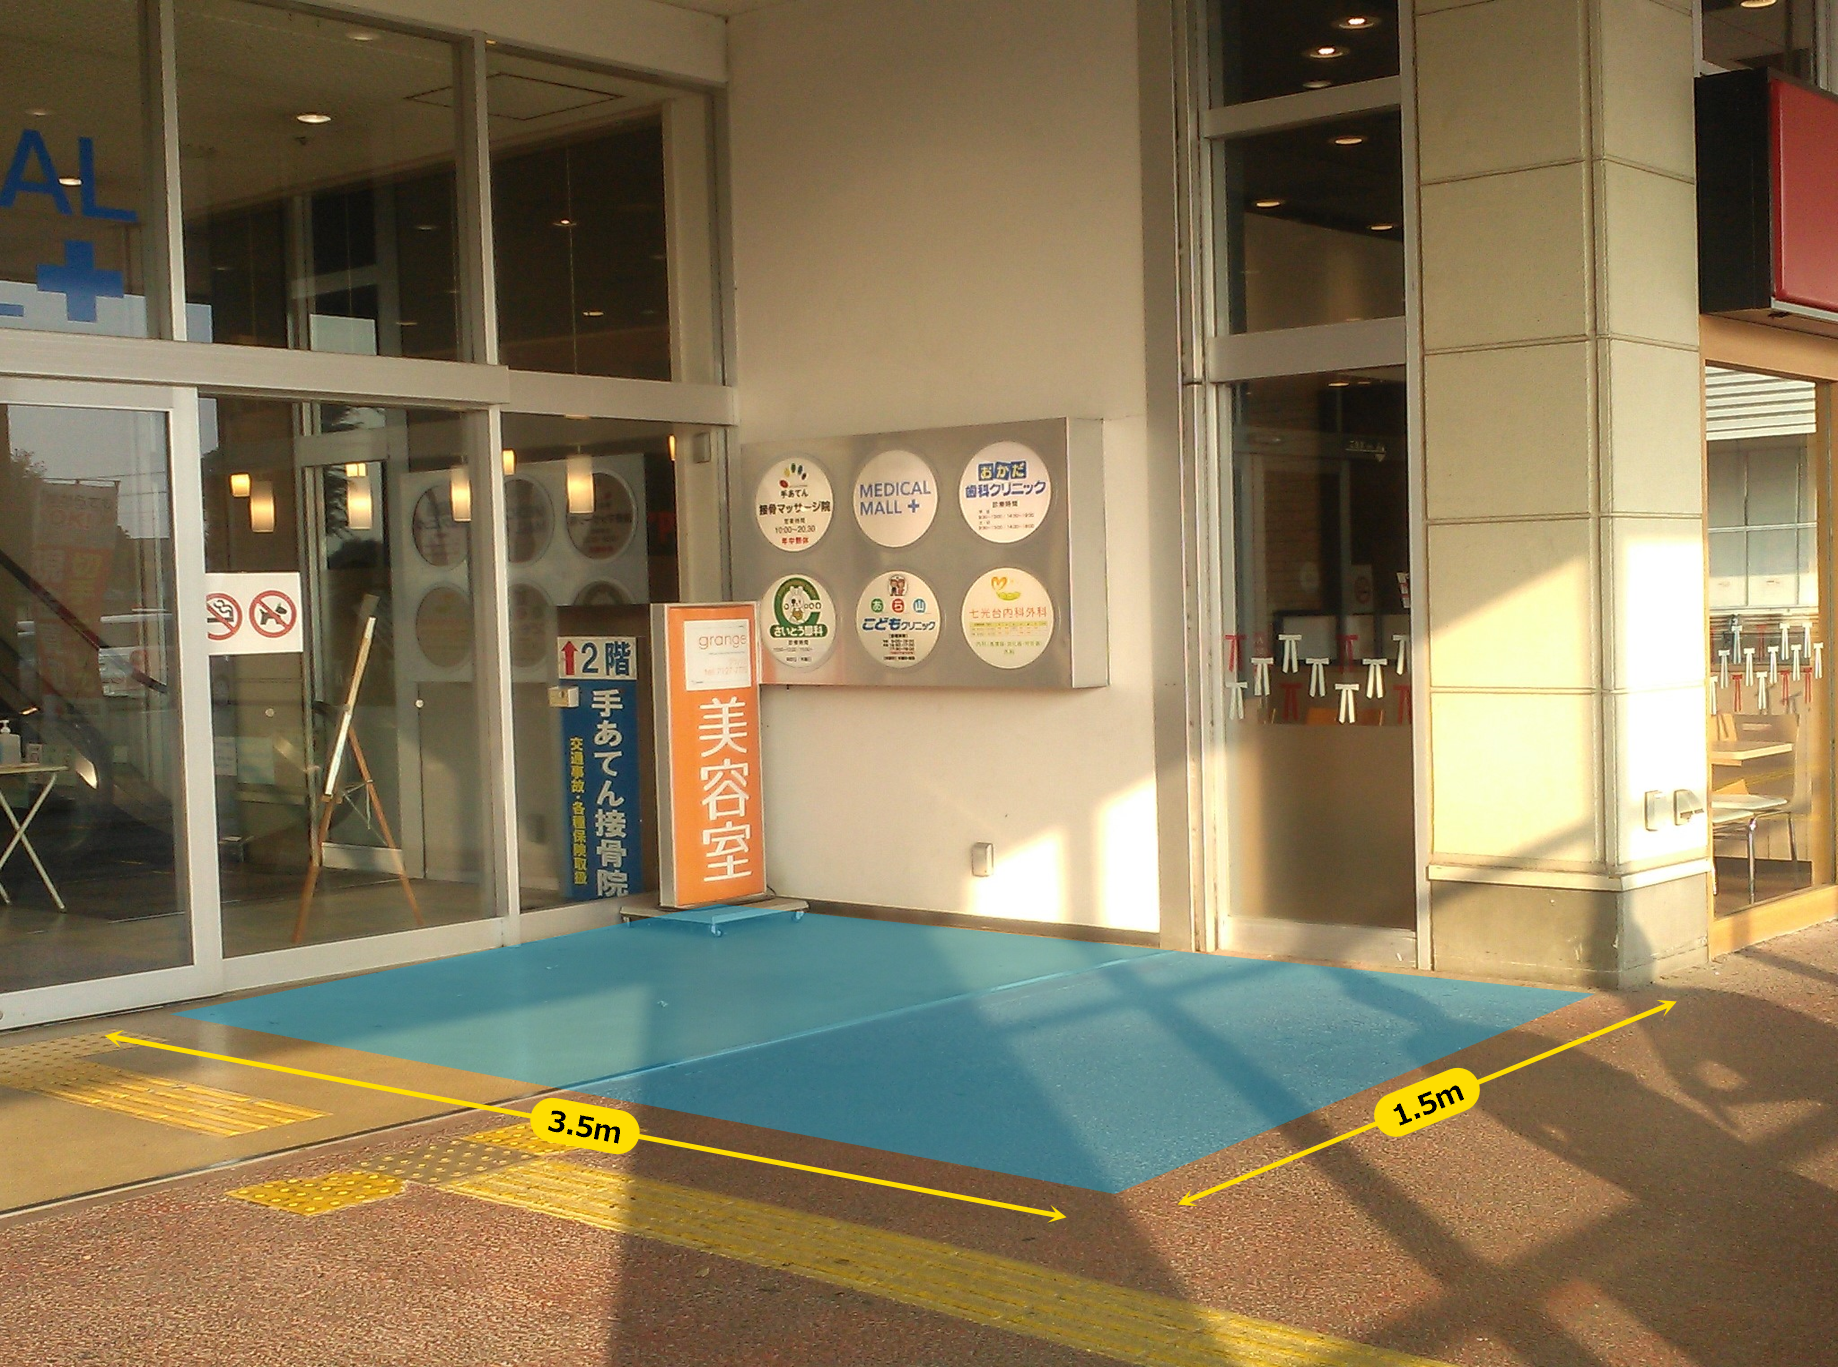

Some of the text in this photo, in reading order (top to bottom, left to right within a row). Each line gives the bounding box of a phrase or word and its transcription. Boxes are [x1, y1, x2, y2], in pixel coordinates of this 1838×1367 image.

[979, 462, 1026, 481] おかだ
[780, 489, 809, 499] 手あてん
[860, 481, 931, 498] MEDICAL
[965, 481, 1046, 498] 歯科クリニック
[759, 501, 831, 515] 接骨マッサージ院
[860, 500, 902, 516] MALL
[969, 606, 1047, 619] 七光台内科外科
[862, 617, 936, 631] こどもクリニック
[699, 635, 747, 650] grange
[581, 641, 631, 675] 2階
[591, 688, 629, 898] 手あてん接骨院
[698, 696, 752, 882] 美容室
